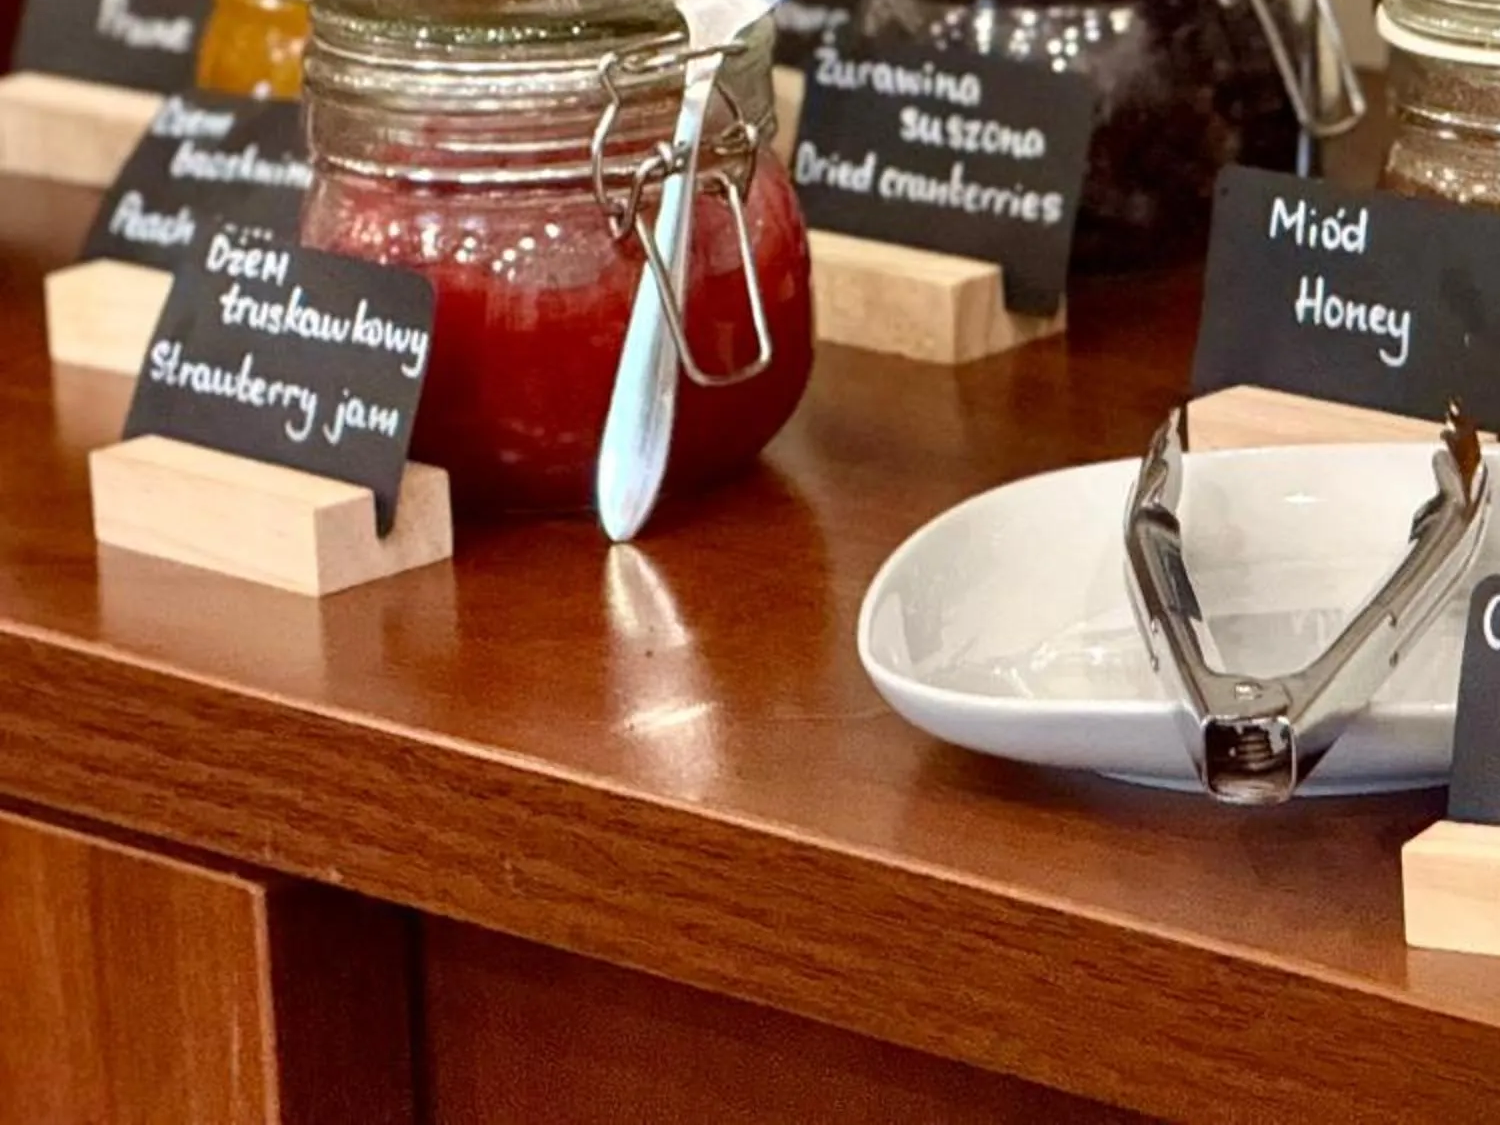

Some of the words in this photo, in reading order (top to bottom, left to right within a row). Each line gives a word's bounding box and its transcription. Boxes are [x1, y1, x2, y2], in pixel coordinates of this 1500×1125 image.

[794, 140, 878, 193] Dried
[878, 160, 1064, 224] cranberries
[1268, 196, 1368, 254] Miód
[218, 283, 429, 378] truskawkowy
[1295, 276, 1411, 367] Honey
[323, 388, 400, 444] jam
